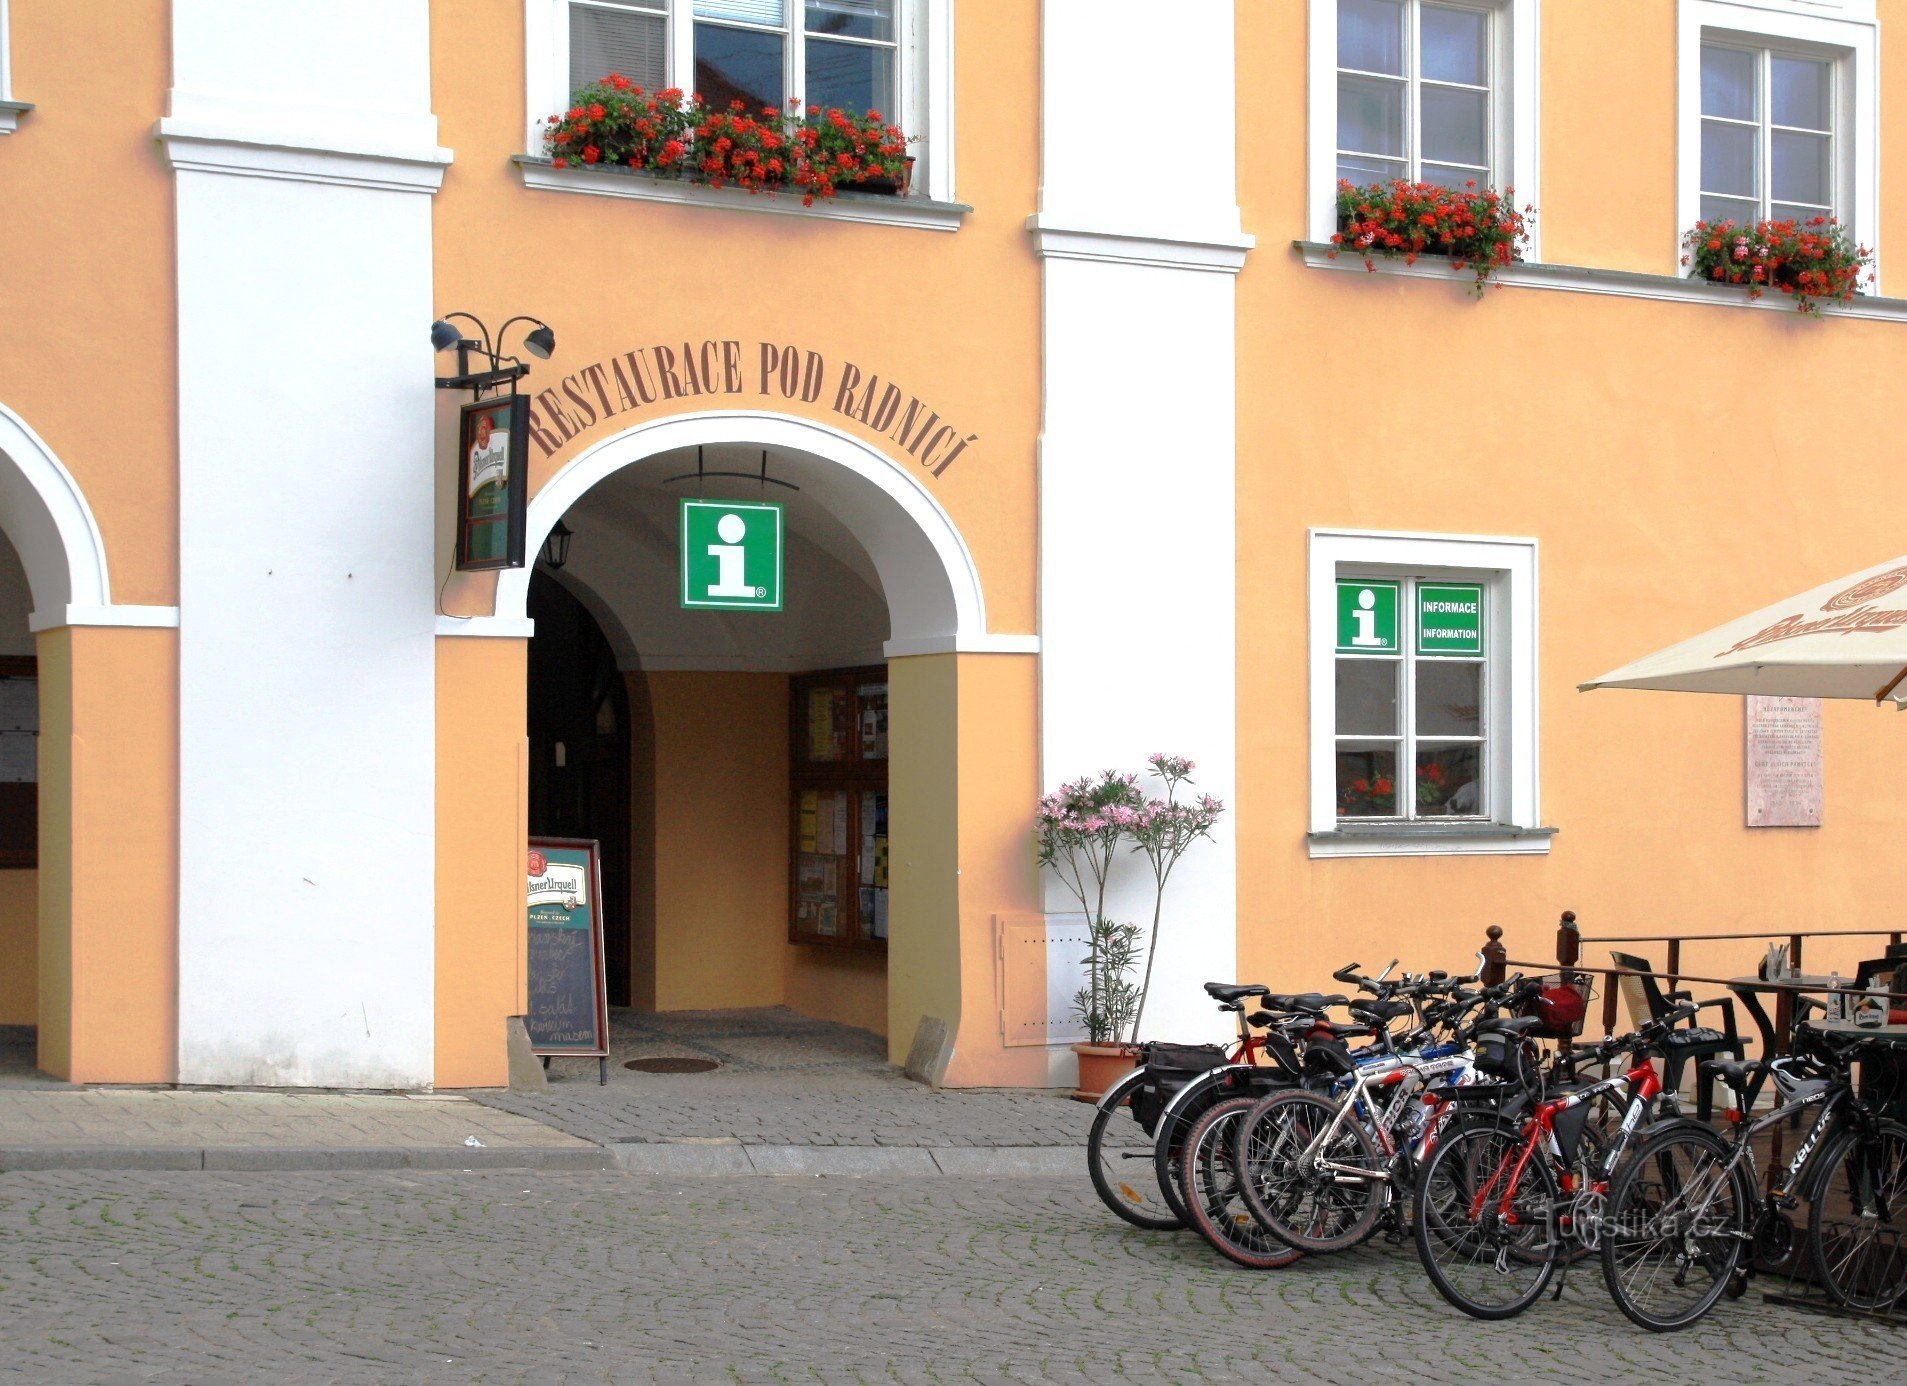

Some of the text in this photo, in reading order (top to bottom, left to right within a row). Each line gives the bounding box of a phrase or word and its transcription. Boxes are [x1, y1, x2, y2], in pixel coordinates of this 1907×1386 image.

[528, 341, 979, 480] RESTAURACE POD RADNICÍ
[1423, 601, 1477, 614] INFORMACE
[1423, 628, 1477, 639] INFORMATION
[546, 876, 577, 895] Urquell
